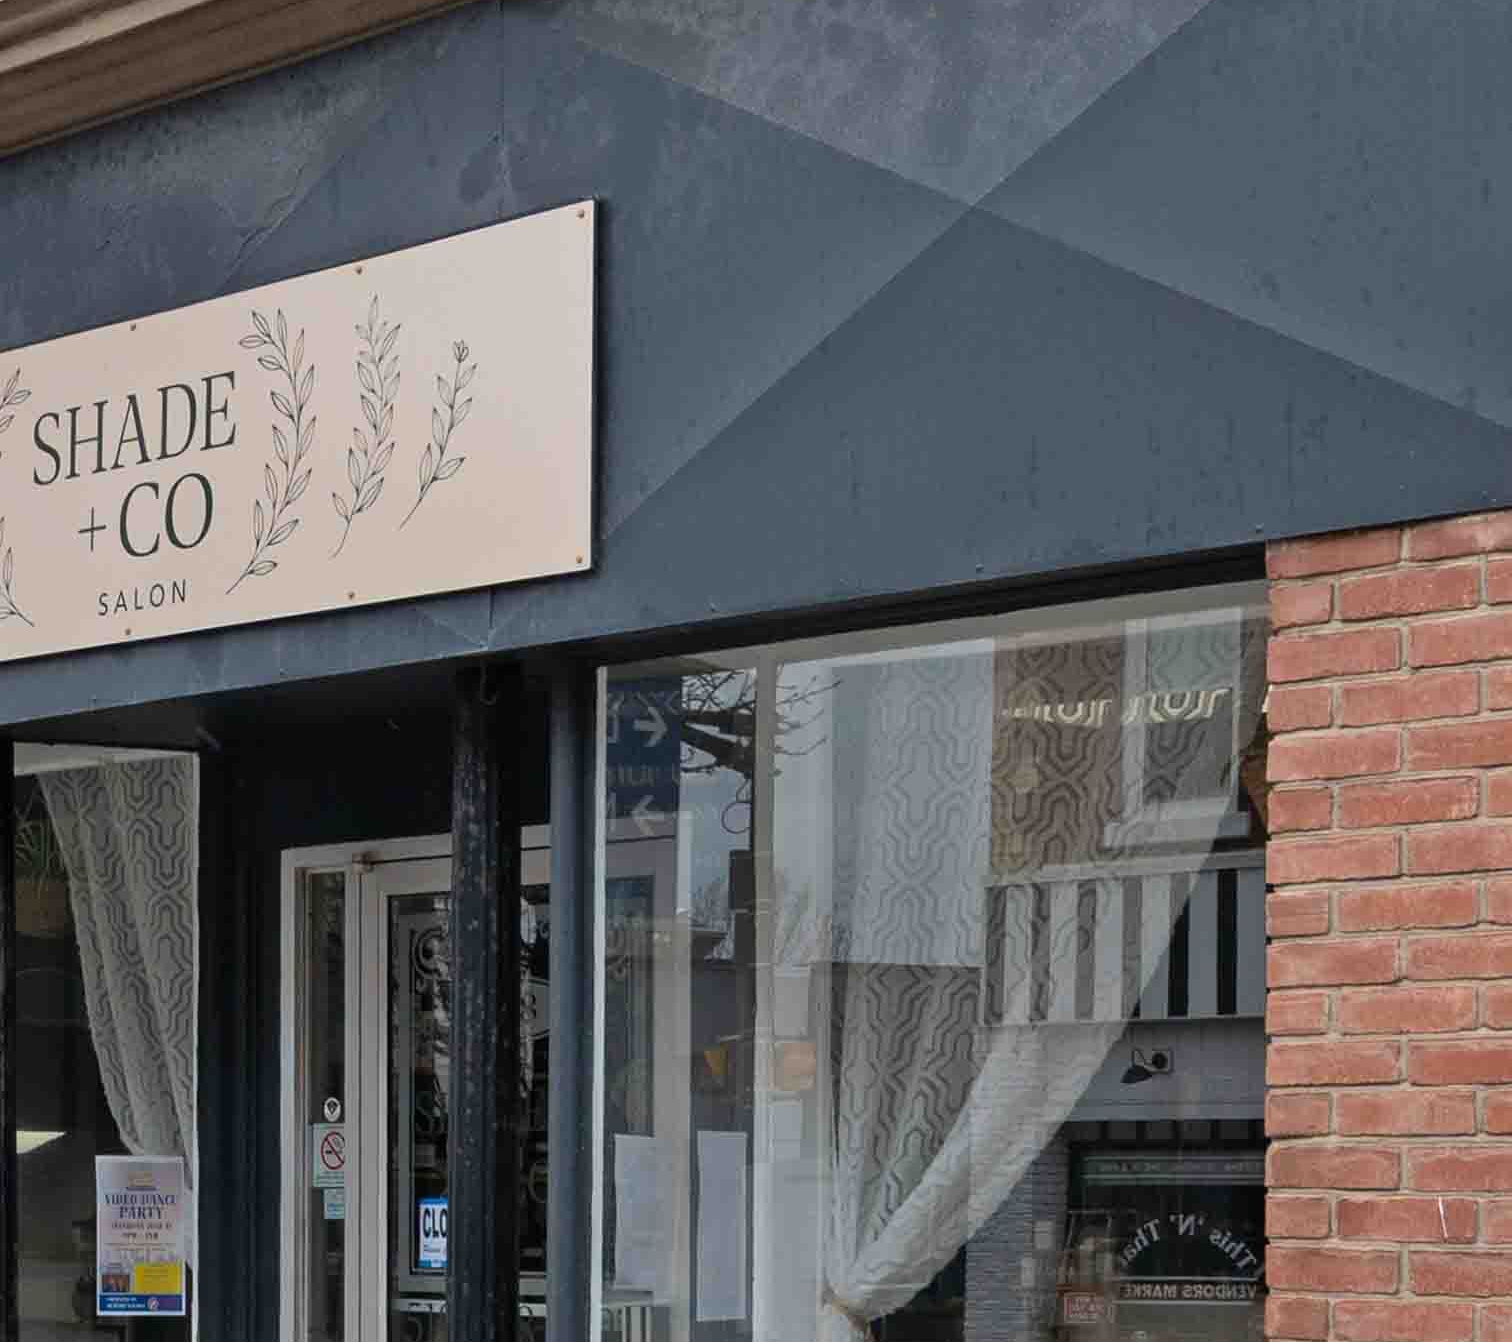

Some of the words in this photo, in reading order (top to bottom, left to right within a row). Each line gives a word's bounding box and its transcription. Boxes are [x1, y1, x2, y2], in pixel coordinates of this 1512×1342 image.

[33, 371, 236, 485] SHADE
[98, 579, 187, 616] SALON
[423, 1207, 449, 1239] CLO
